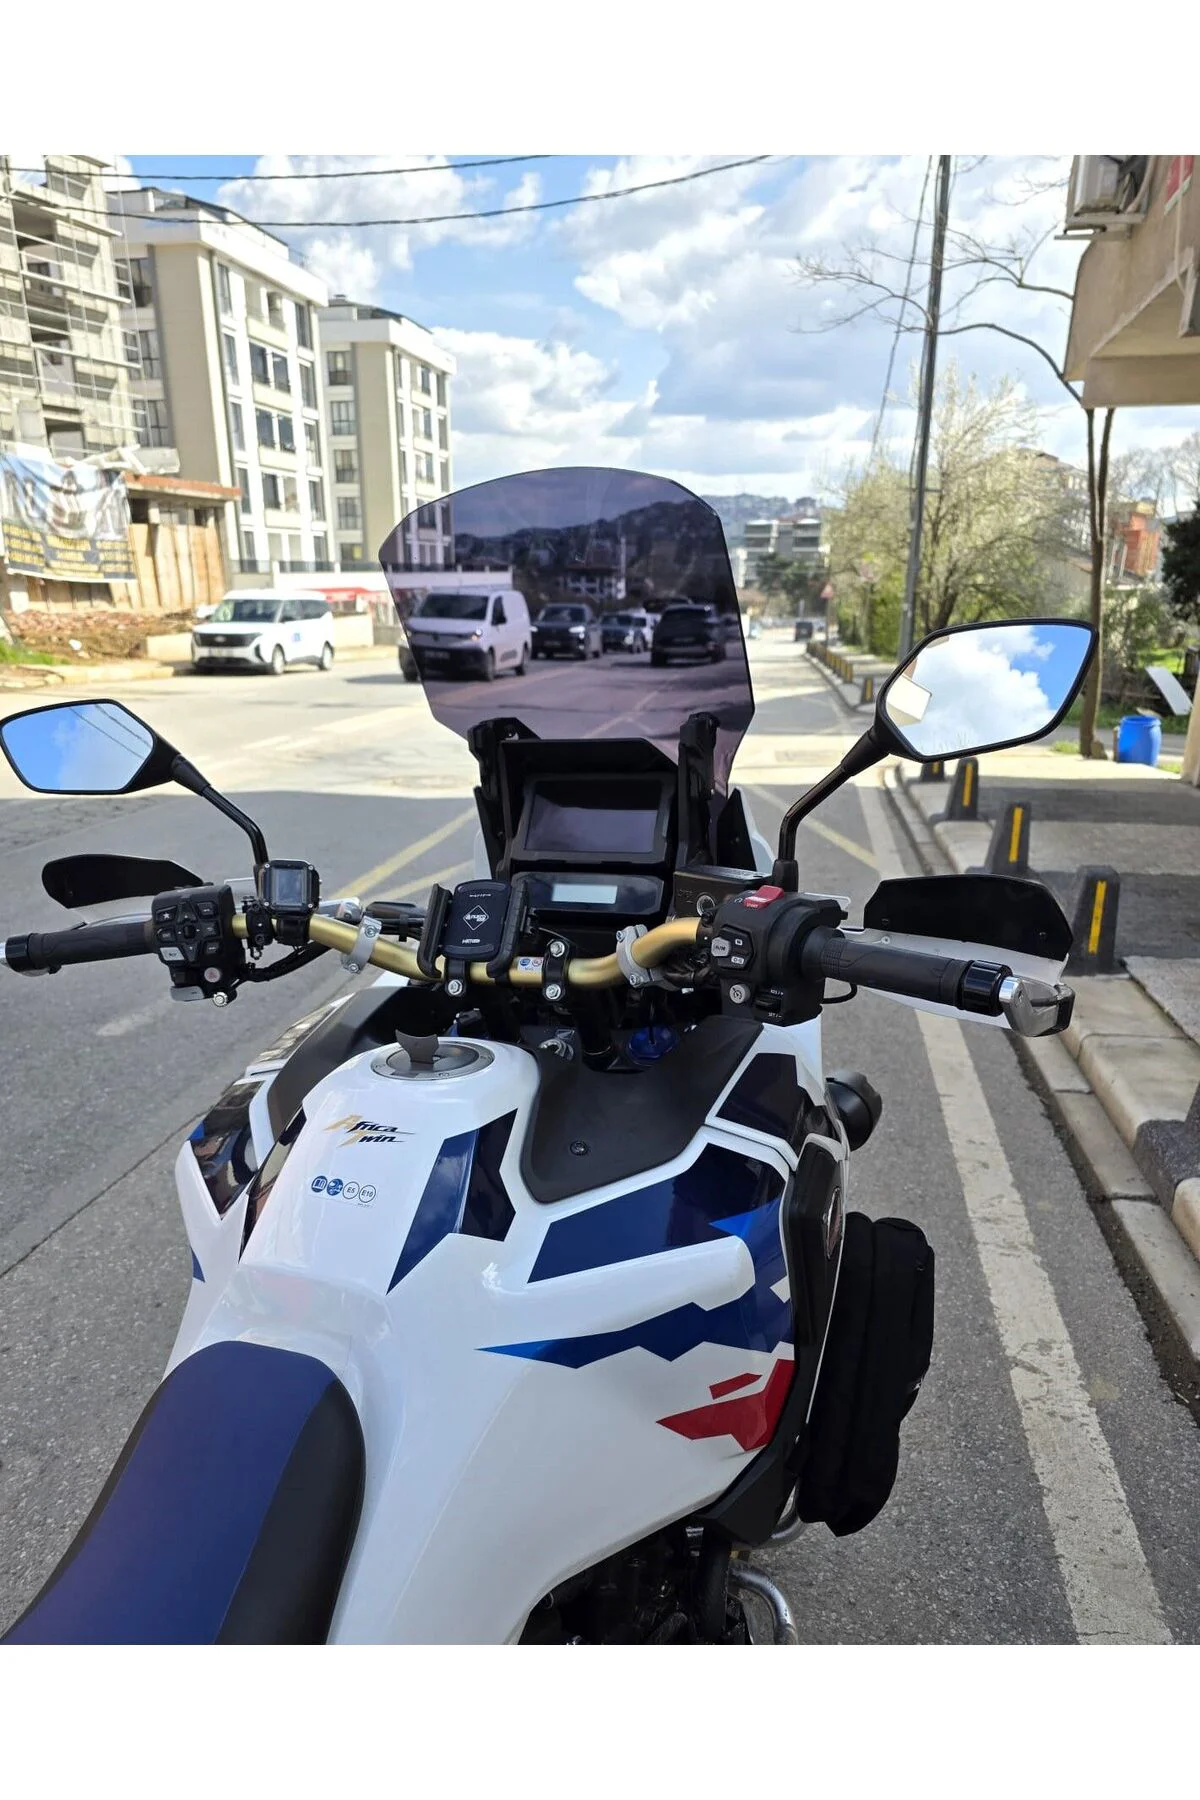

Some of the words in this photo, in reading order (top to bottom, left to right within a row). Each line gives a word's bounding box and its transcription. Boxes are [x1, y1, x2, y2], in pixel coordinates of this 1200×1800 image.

[323, 1115, 415, 1134] Africa
[338, 1131, 405, 1147] Twin
[361, 1190, 374, 1198] E10
